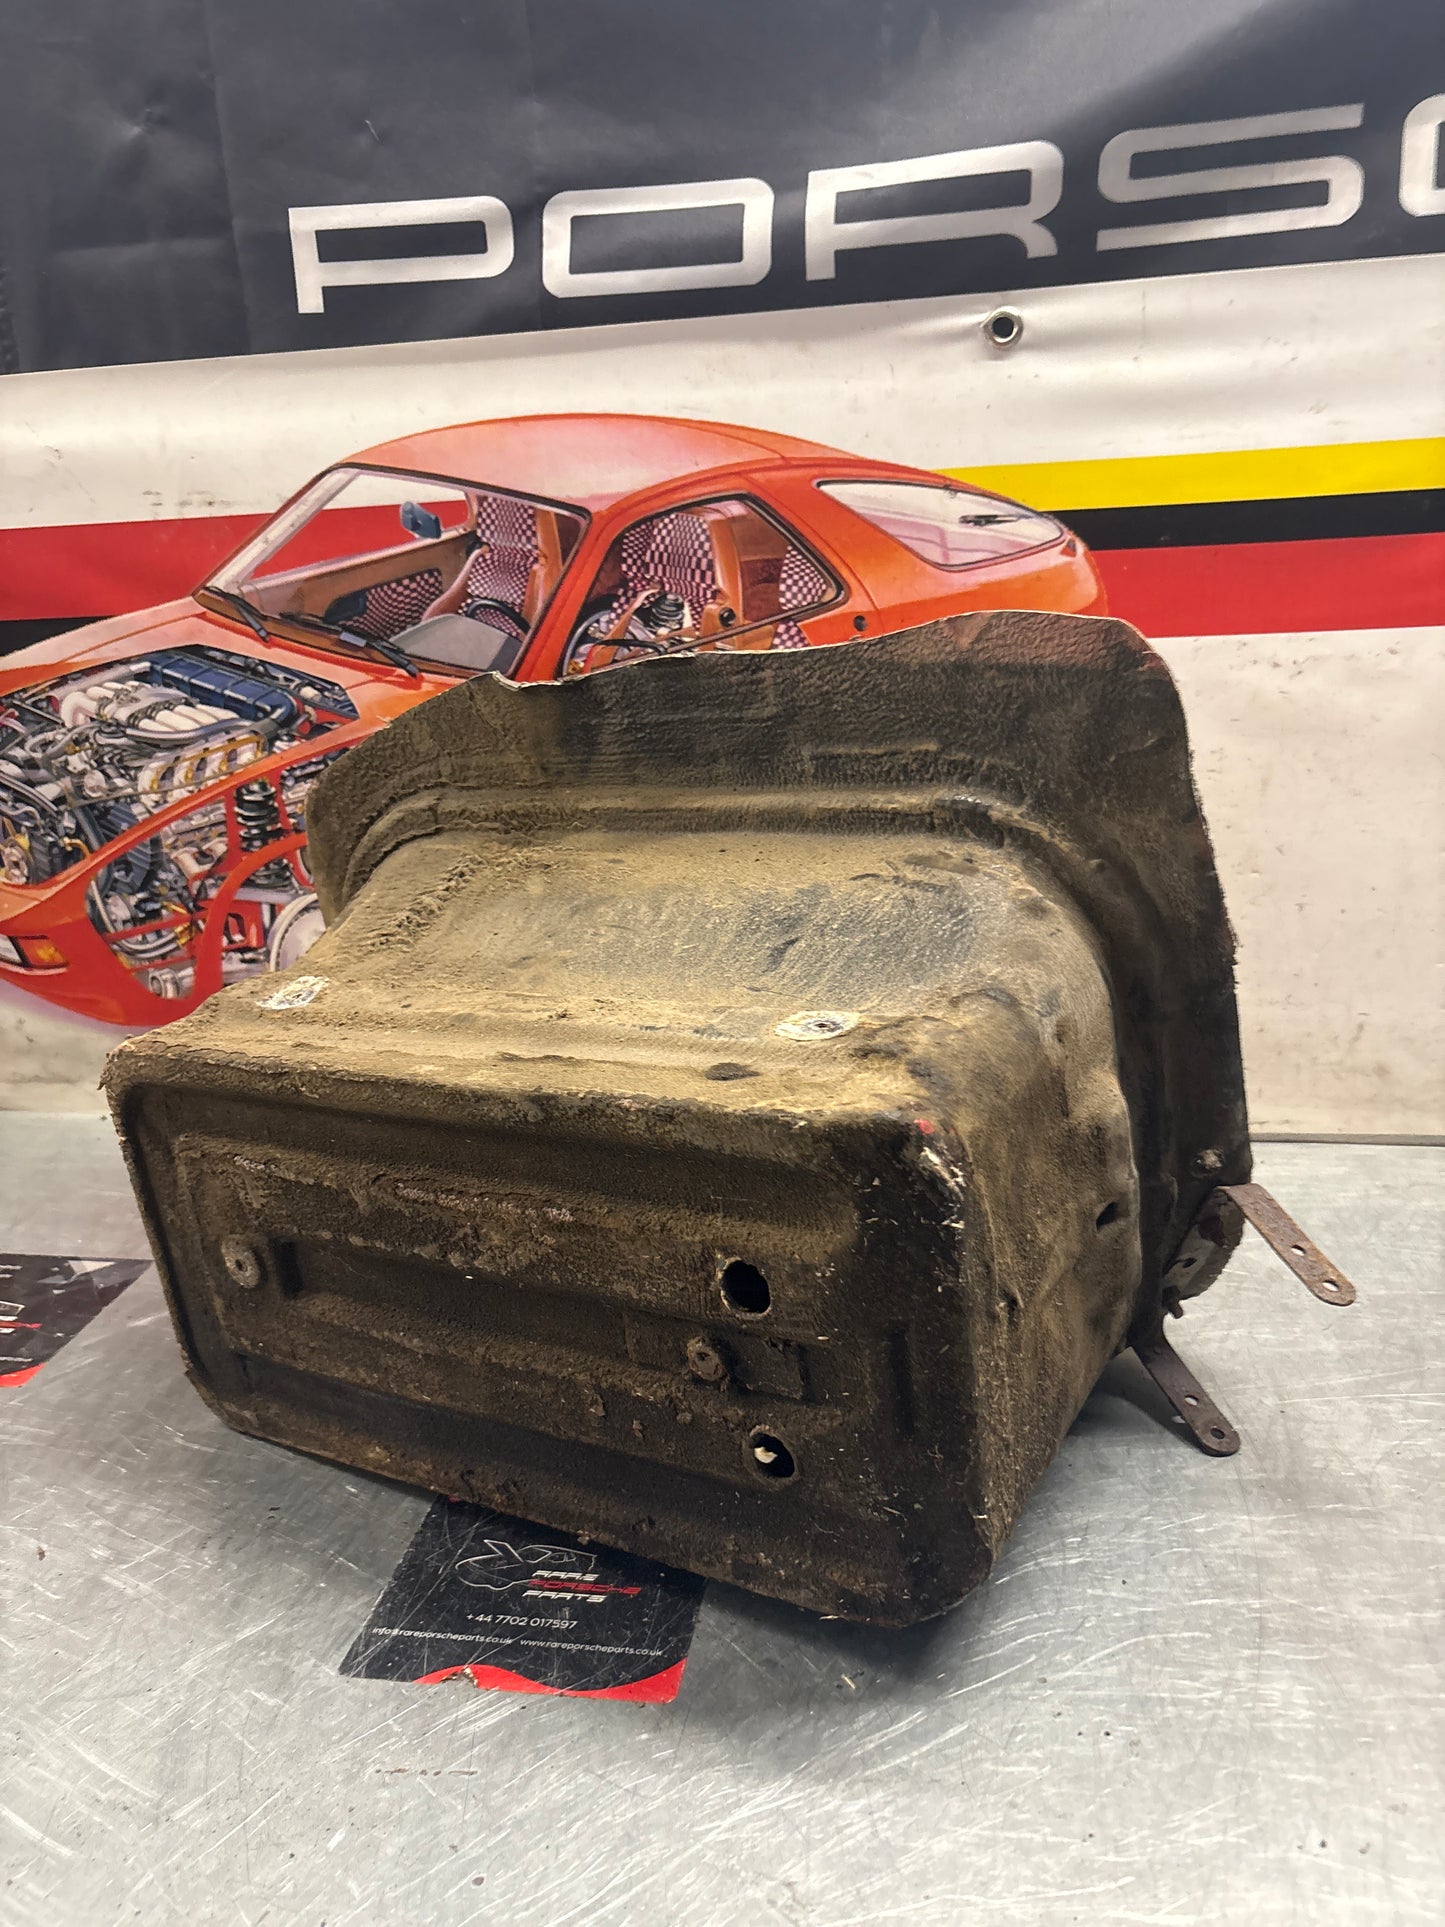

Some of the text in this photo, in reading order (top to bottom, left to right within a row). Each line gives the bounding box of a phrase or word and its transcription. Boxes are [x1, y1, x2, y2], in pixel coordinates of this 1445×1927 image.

[288, 92, 1445, 314] PORS
[531, 1570, 599, 1581] RARE
[528, 1579, 642, 1594] PORSCHE
[521, 1590, 607, 1602] PARTS
[466, 1613, 578, 1629] +44 7702 017597
[372, 1626, 663, 1656] info@rareporscheparts.co.uk www.rareporscheparts.co.uk
